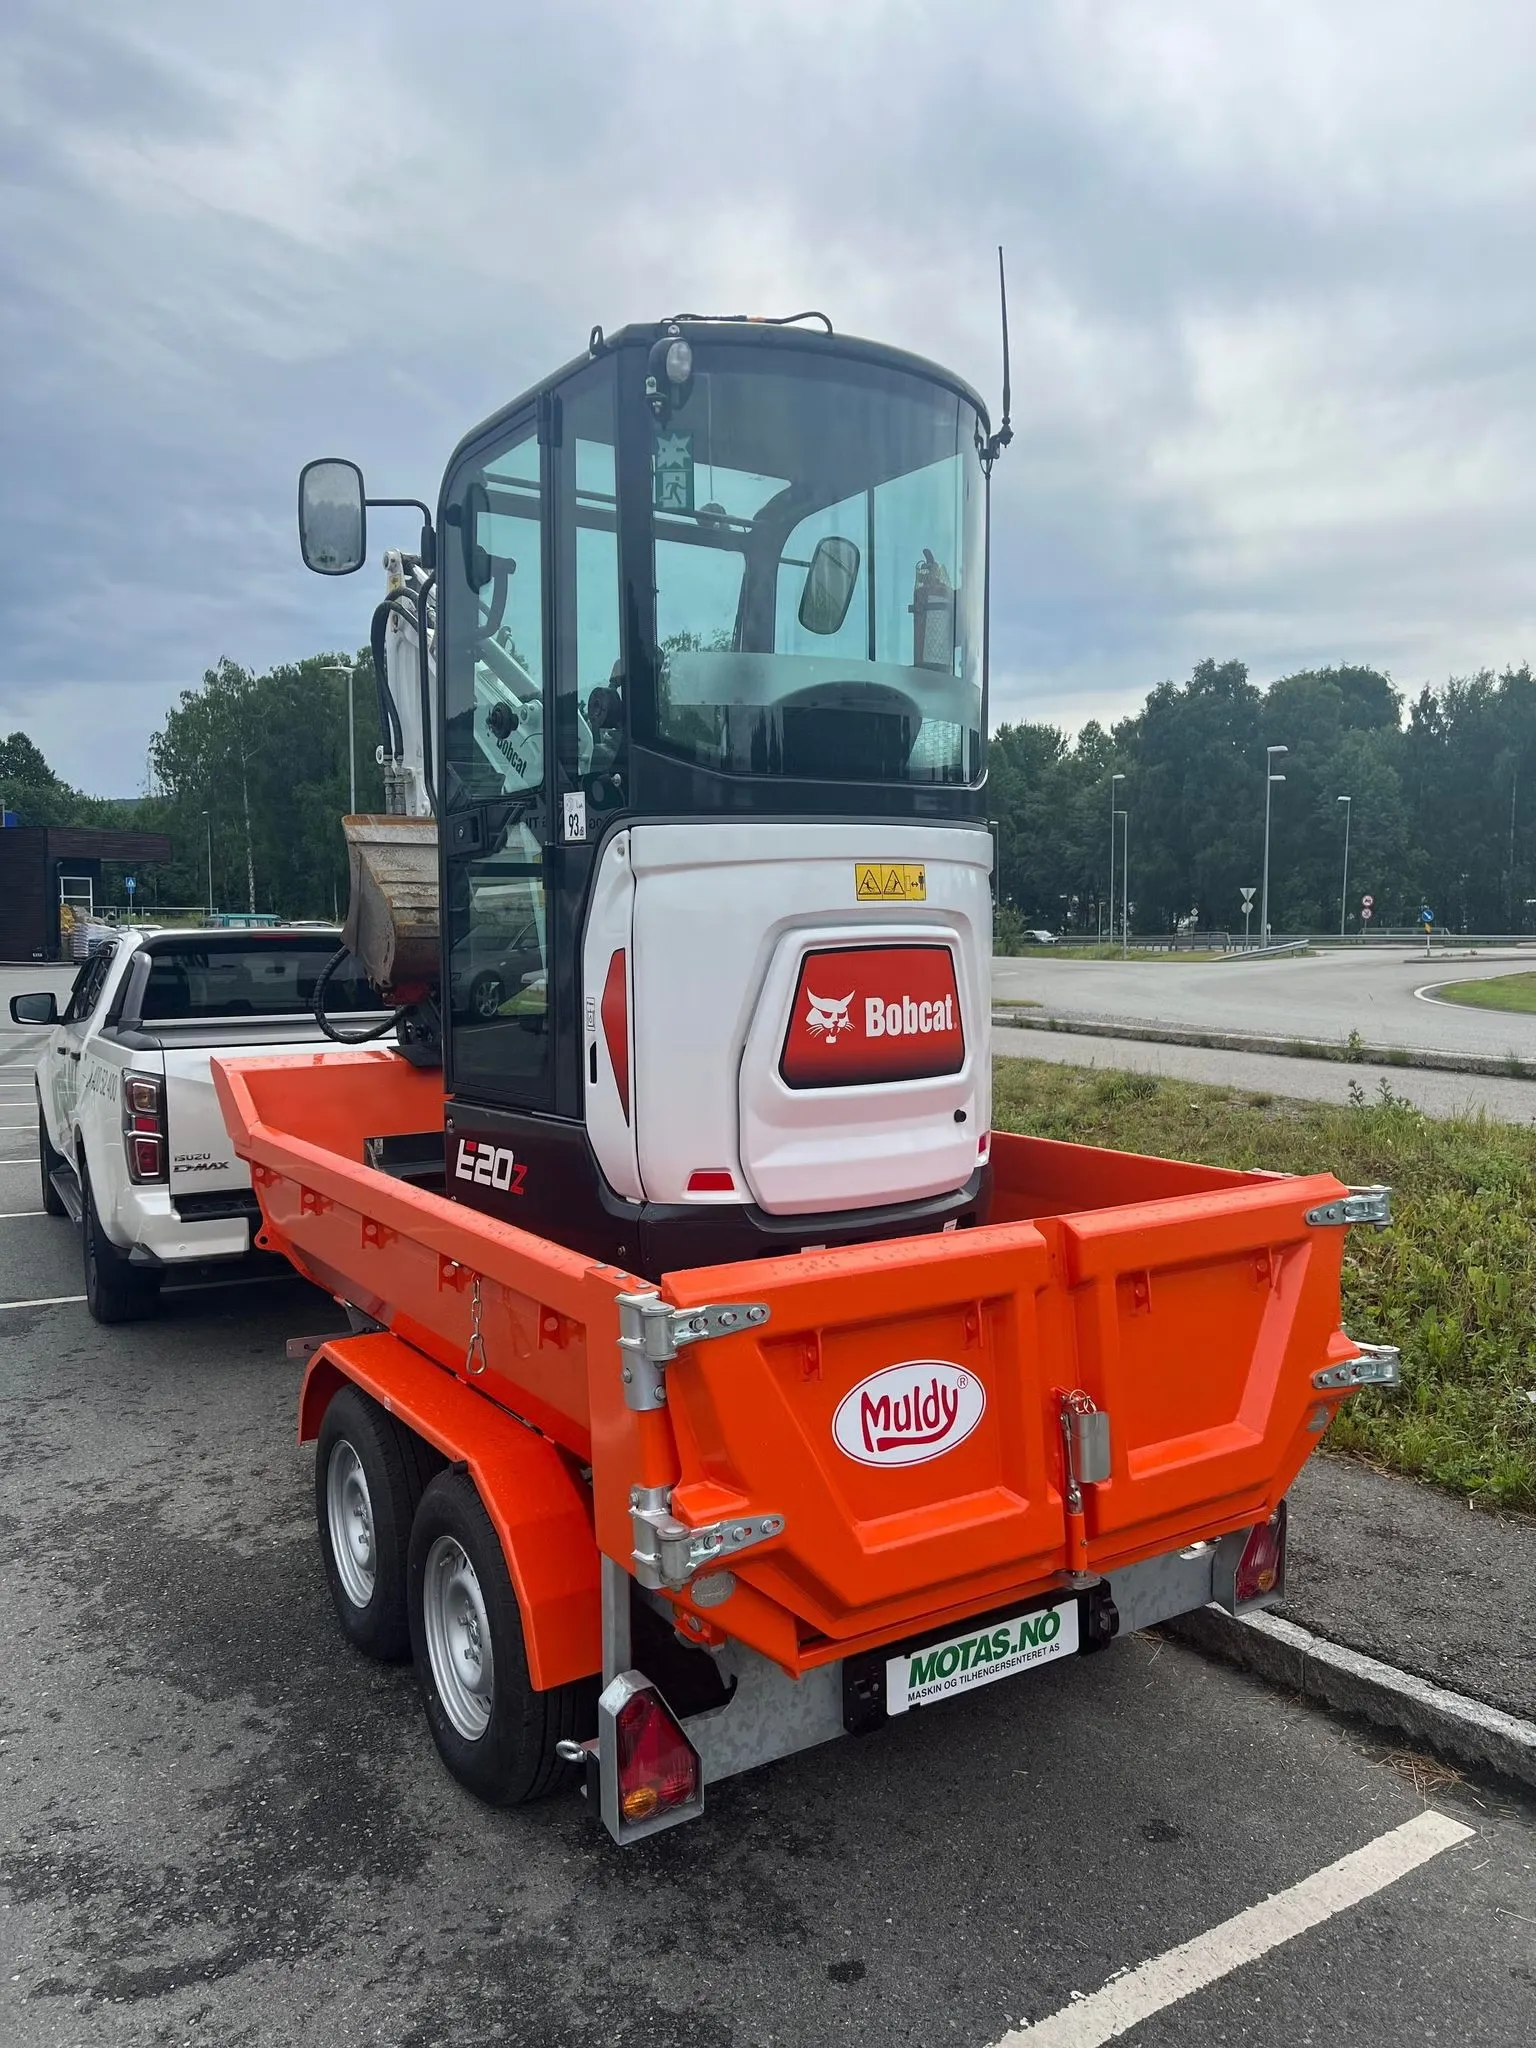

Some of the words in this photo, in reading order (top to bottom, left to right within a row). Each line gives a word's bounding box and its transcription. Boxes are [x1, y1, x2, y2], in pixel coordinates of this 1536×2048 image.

[568, 813, 580, 837] 93
[865, 993, 953, 1038] Bobcat
[172, 1161, 230, 1173] D-MAX
[174, 1152, 211, 1162] ISUZU
[908, 1611, 1061, 1689] MOTAS.NO
[907, 1682, 942, 1702] MASKIN
[943, 1678, 957, 1690] OG
[958, 1646, 1047, 1685] TILHENGERSENTERET
[1049, 1642, 1061, 1653] AS
